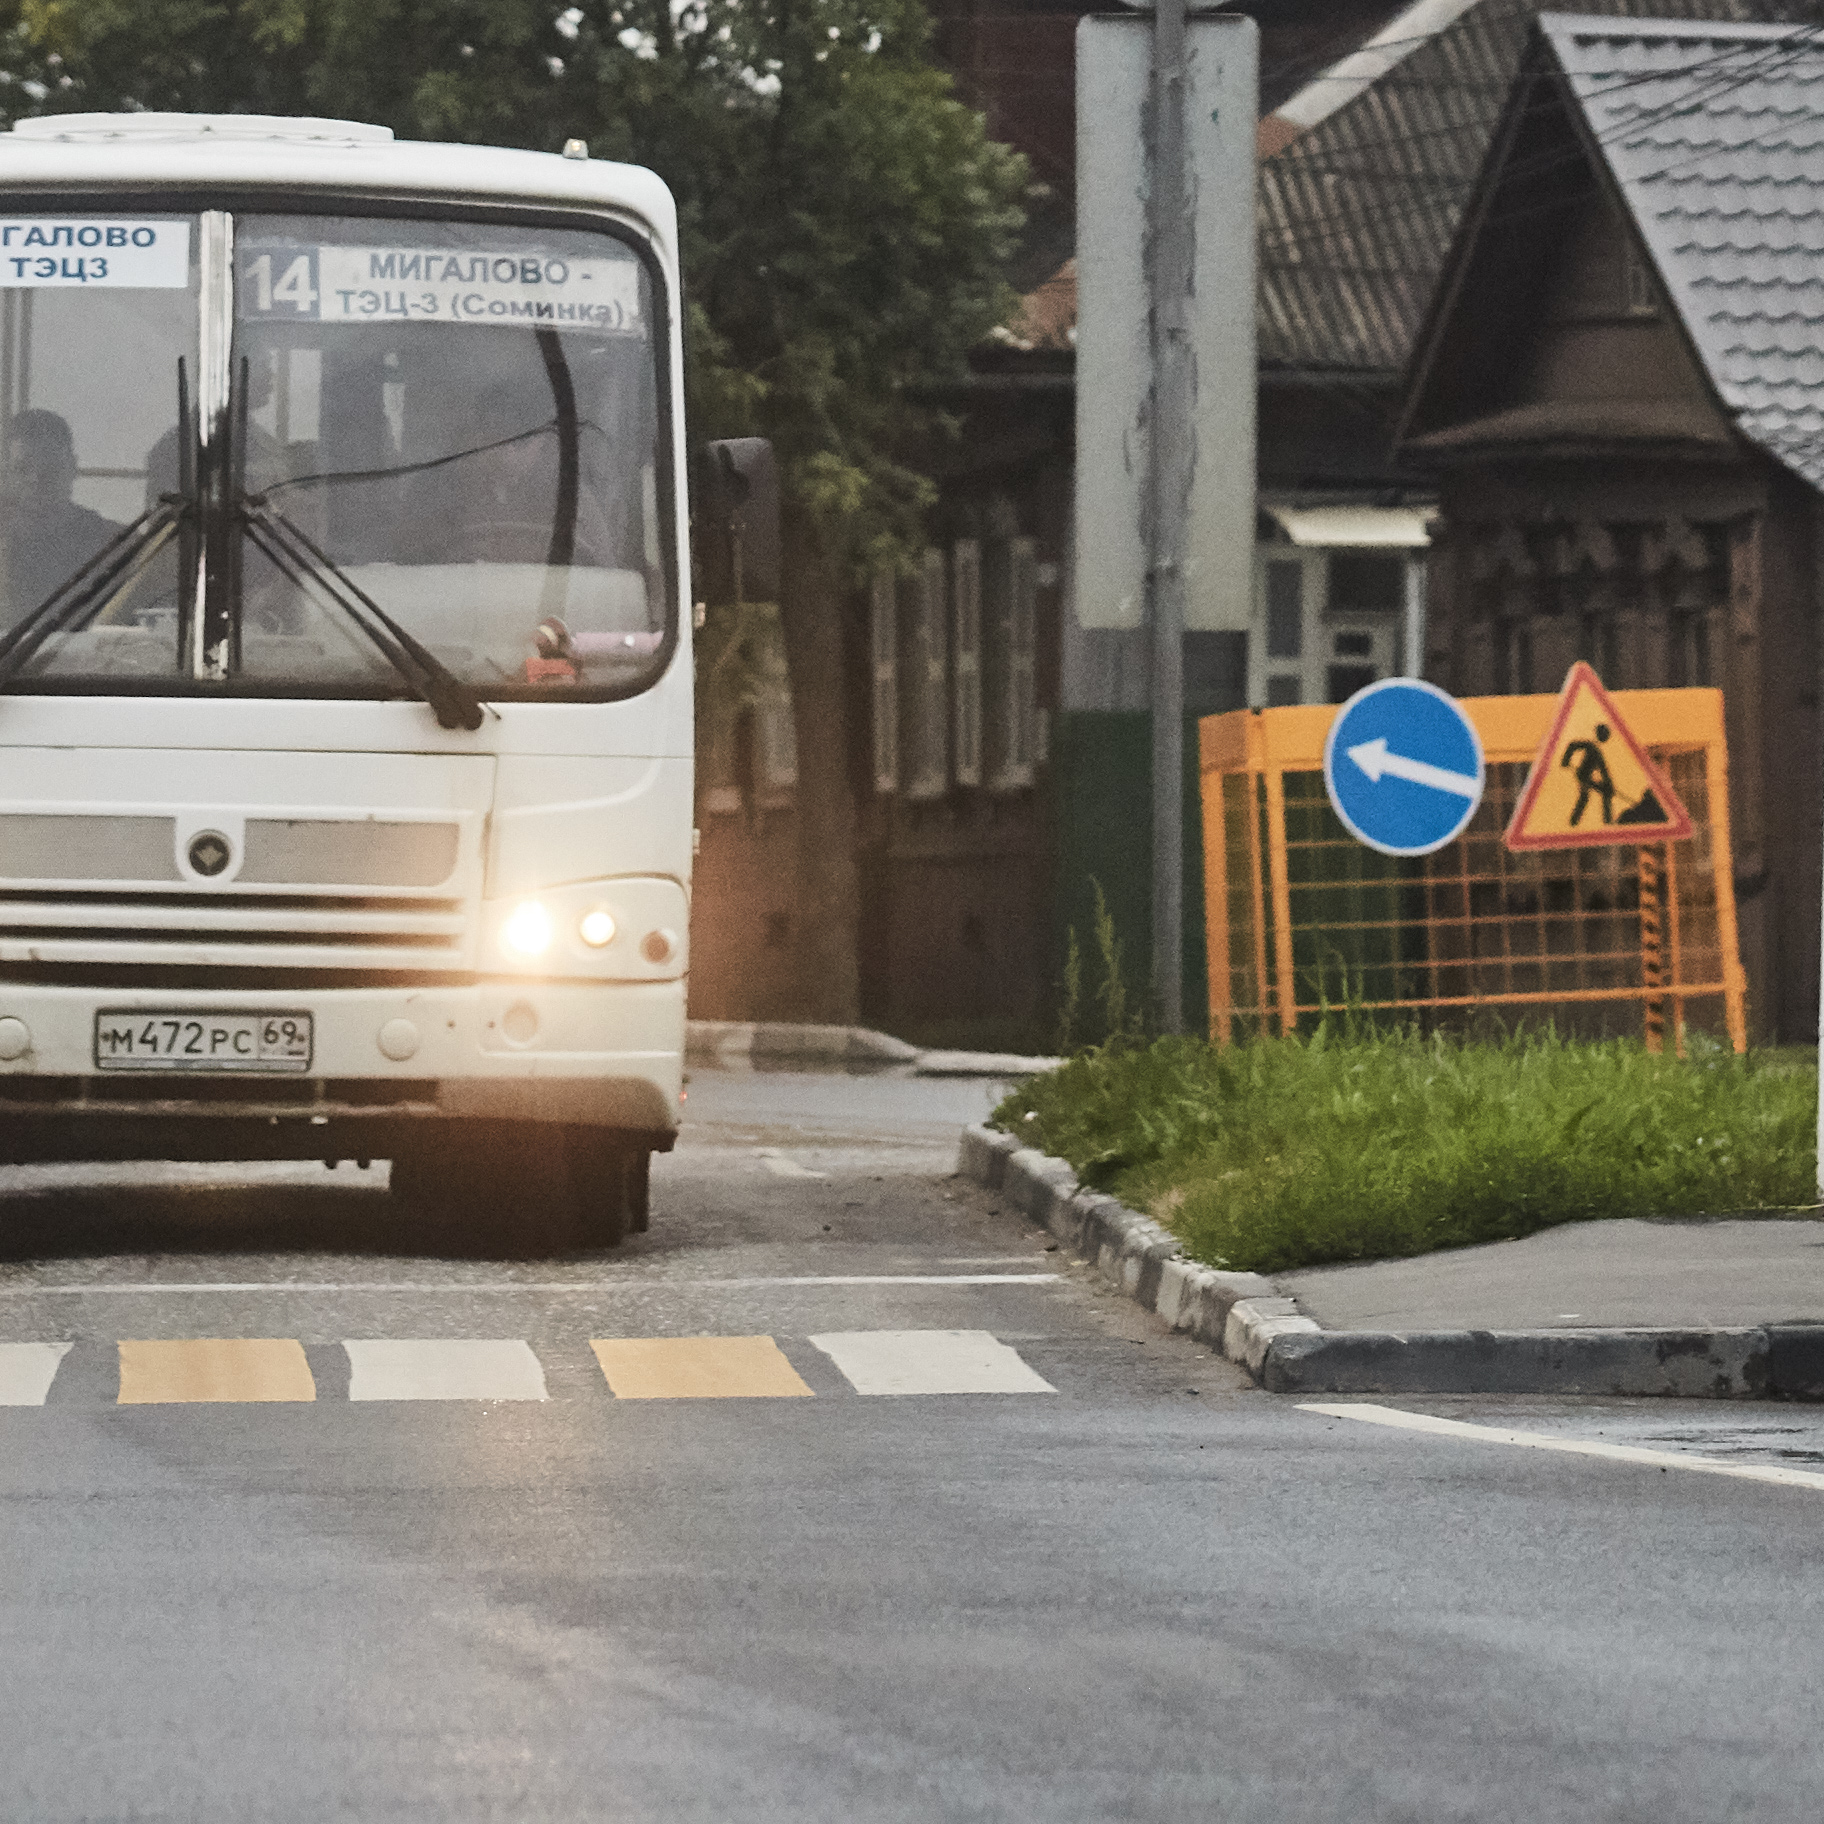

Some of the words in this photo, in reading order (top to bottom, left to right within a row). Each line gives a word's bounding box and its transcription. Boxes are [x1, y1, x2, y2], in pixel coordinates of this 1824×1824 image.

[245, 254, 318, 312] 14
[369, 252, 571, 285] МИГАЛОВО
[335, 288, 440, 316] ТЭЦ-3
[450, 291, 626, 326] (Соминка)
[109, 1020, 253, 1054] М472РС
[263, 1019, 298, 1045] 69
